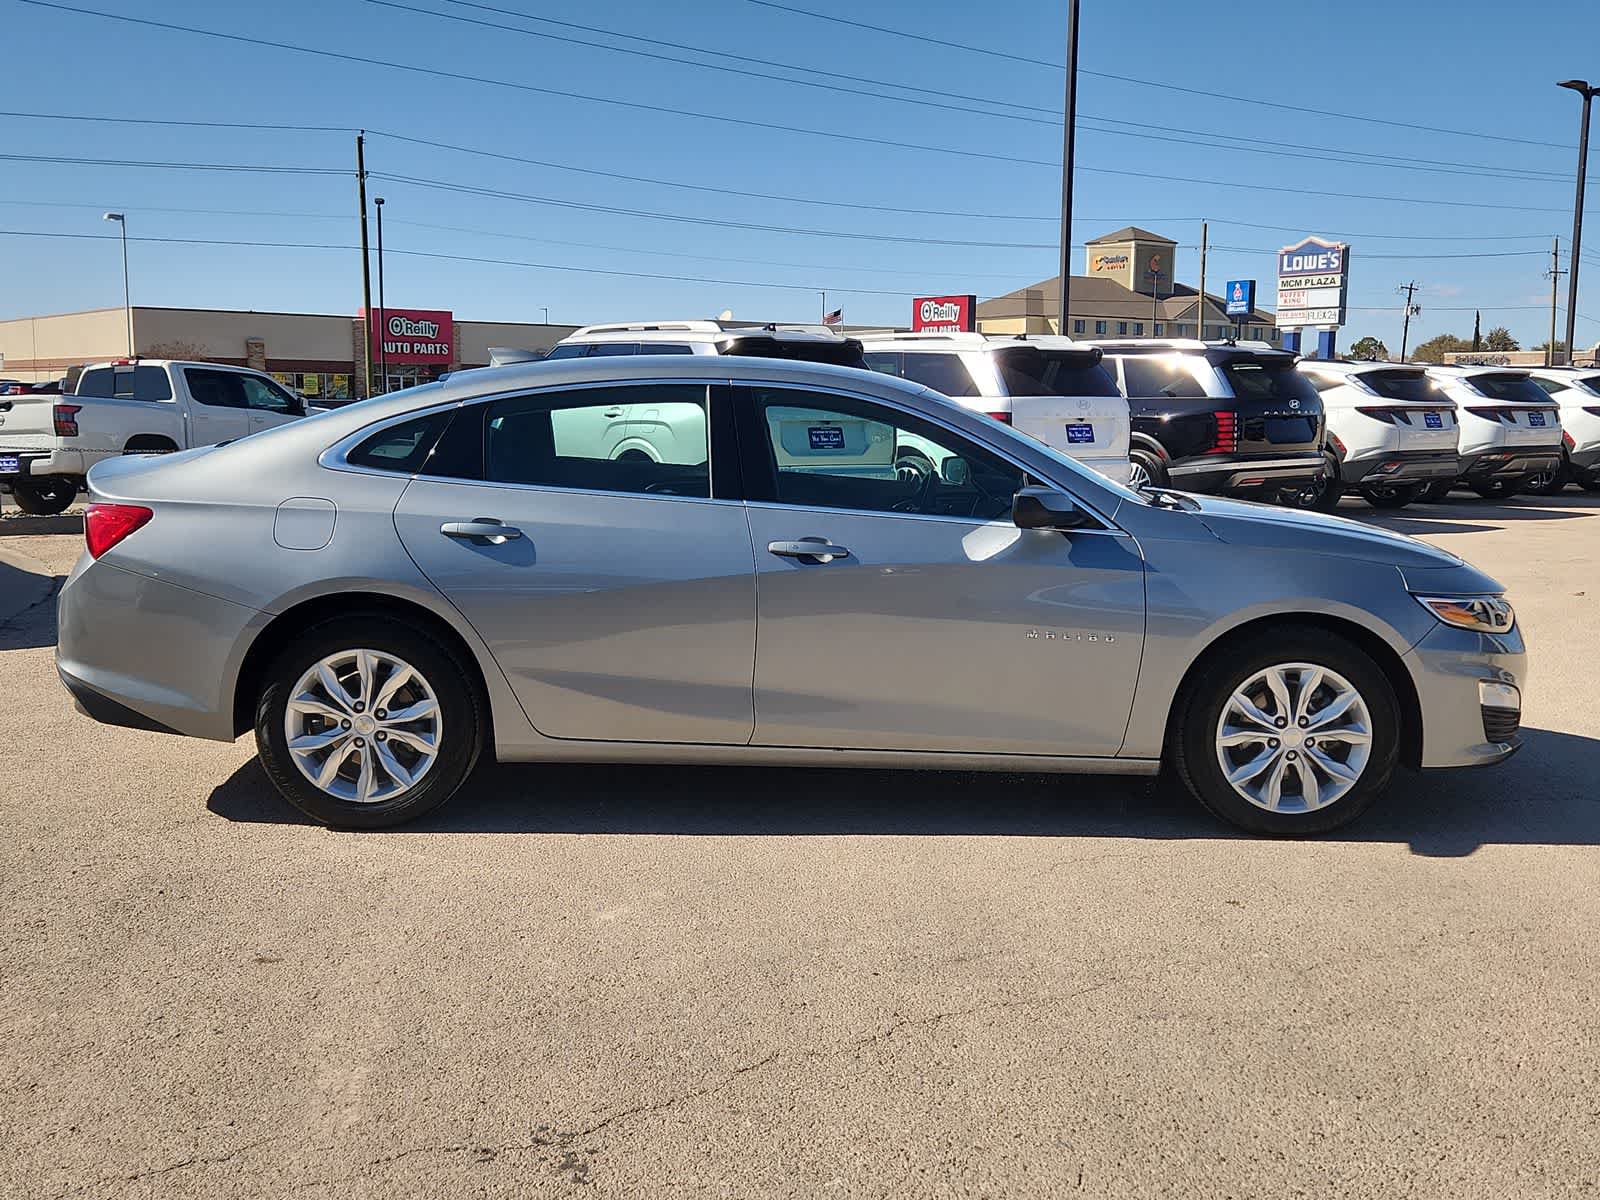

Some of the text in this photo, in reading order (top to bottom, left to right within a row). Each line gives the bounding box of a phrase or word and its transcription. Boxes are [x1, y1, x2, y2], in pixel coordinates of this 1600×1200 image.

[1283, 252, 1340, 271] LOWE'S
[1281, 277, 1336, 288] MCM PLAZA
[921, 301, 960, 322] O'Reilly
[390, 317, 438, 338] O'Reilly
[413, 343, 448, 355] PARTS
[1026, 630, 1114, 642] MALIBU
